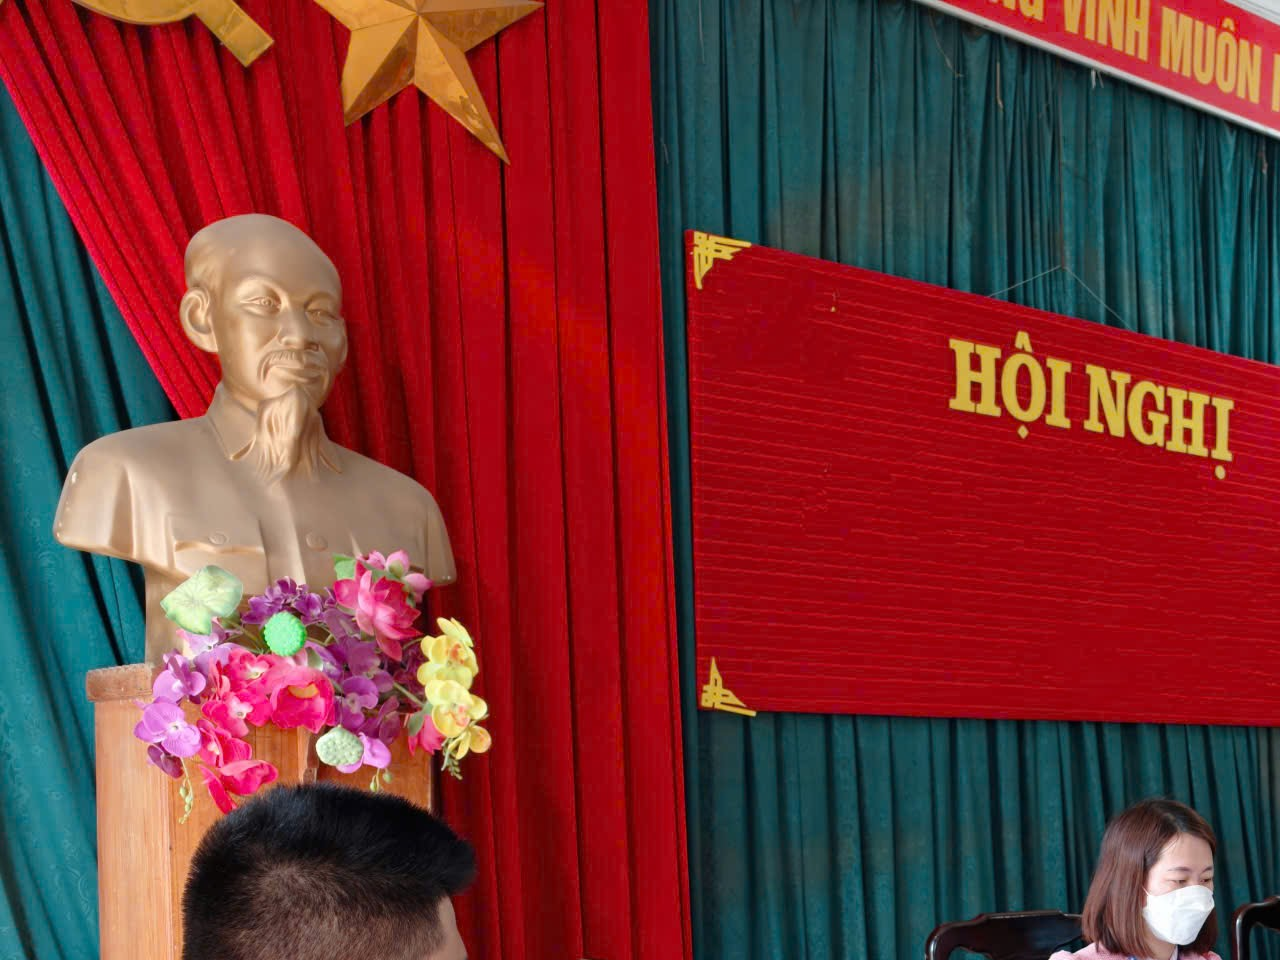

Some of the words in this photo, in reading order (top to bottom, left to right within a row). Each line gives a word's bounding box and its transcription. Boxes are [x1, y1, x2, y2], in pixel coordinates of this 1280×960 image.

[1063, 0, 1150, 62] VINH
[1160, 6, 1262, 105] MUÔN
[949, 331, 1072, 439] HỘI
[1083, 363, 1234, 480] NGHỊ
